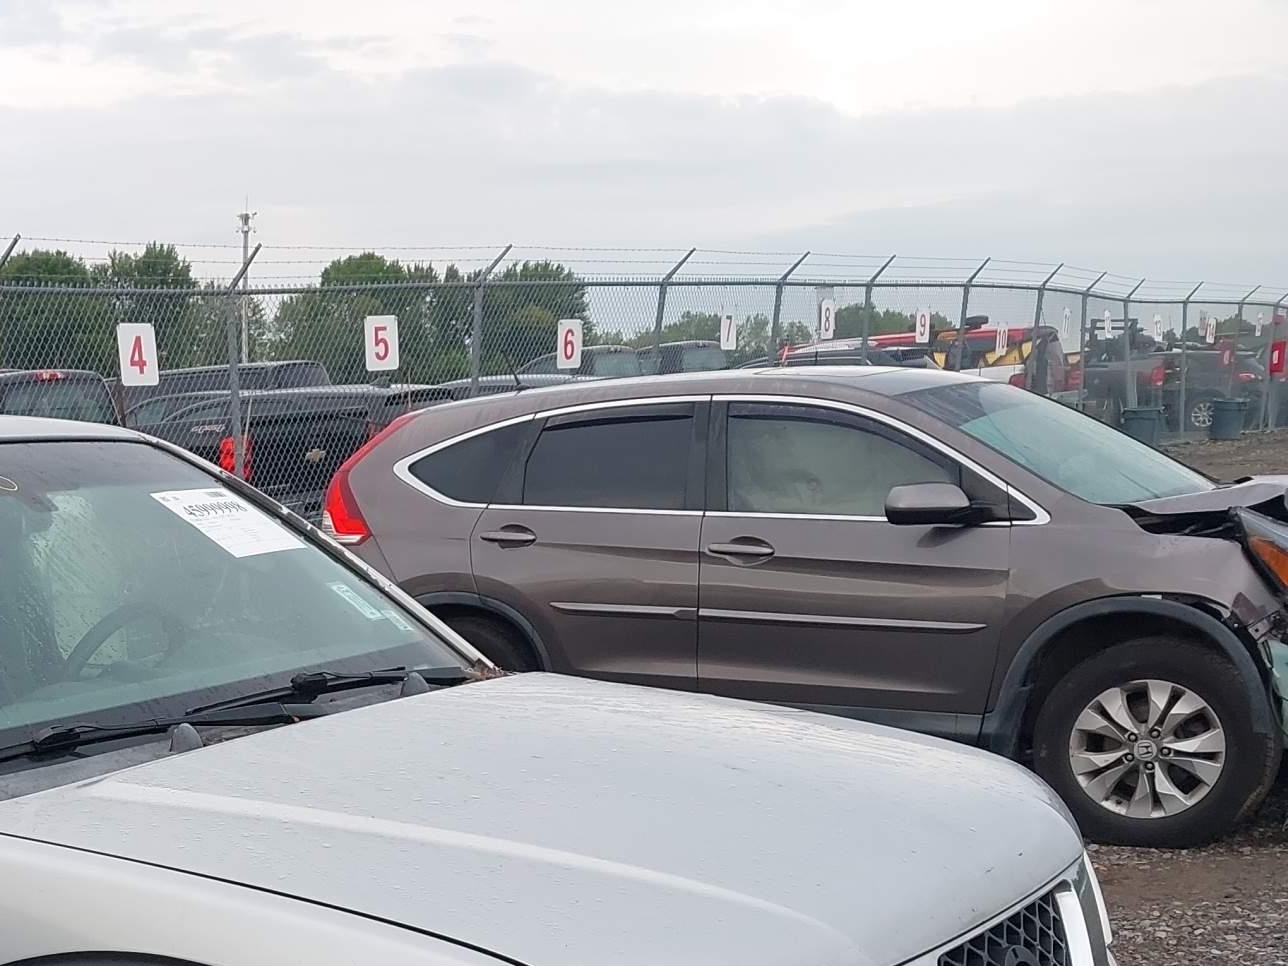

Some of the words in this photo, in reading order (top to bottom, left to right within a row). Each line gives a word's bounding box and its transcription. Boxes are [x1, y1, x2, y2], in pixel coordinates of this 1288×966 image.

[725, 314, 733, 343] 7
[823, 306, 831, 333] 8
[919, 313, 927, 337] 9
[374, 326, 390, 361] 5
[563, 328, 575, 361] 6
[997, 330, 1007, 349] 10
[129, 335, 147, 375] 4
